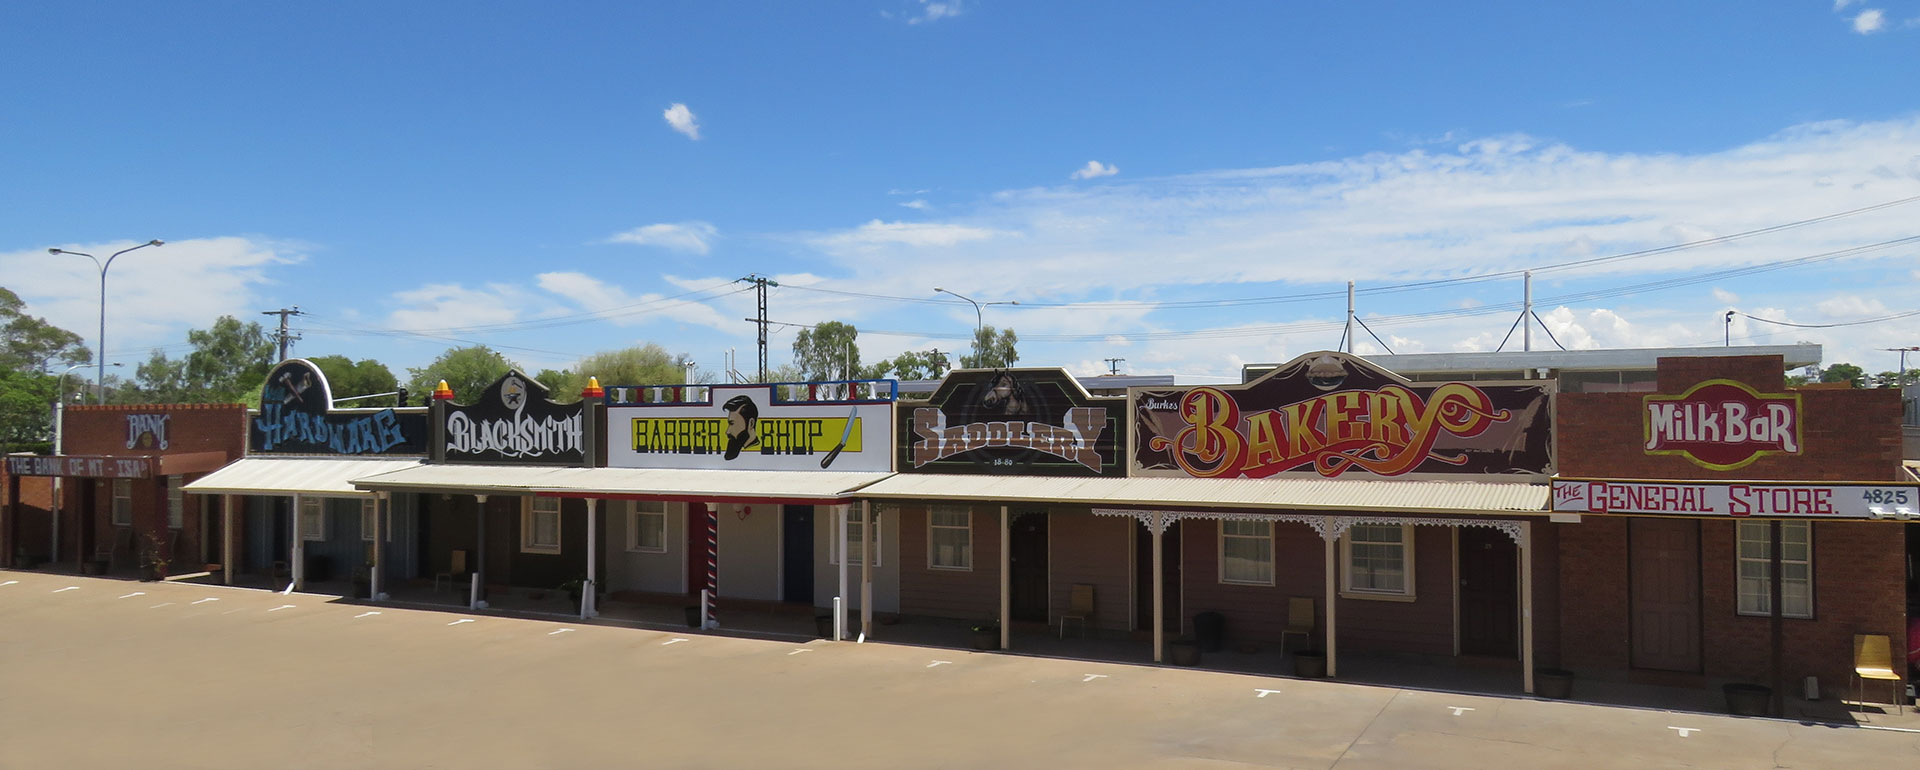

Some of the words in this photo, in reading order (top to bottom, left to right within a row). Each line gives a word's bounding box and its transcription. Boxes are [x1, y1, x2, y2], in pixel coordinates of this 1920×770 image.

[127, 414, 169, 449] BANK
[257, 402, 407, 454] HARDWARE
[636, 419, 722, 454] BARBER
[913, 407, 1107, 473] SADDLERY
[1151, 382, 1511, 478] BAKERY
[8, 457, 31, 474] THE
[34, 457, 63, 475] BANK
[69, 458, 84, 475] OF
[116, 460, 141, 477] ISA
[1553, 483, 1584, 504] THE
[1588, 482, 1714, 513] GENERAL
[1729, 484, 1839, 516] STORE.
[1862, 490, 1909, 505] 4825
